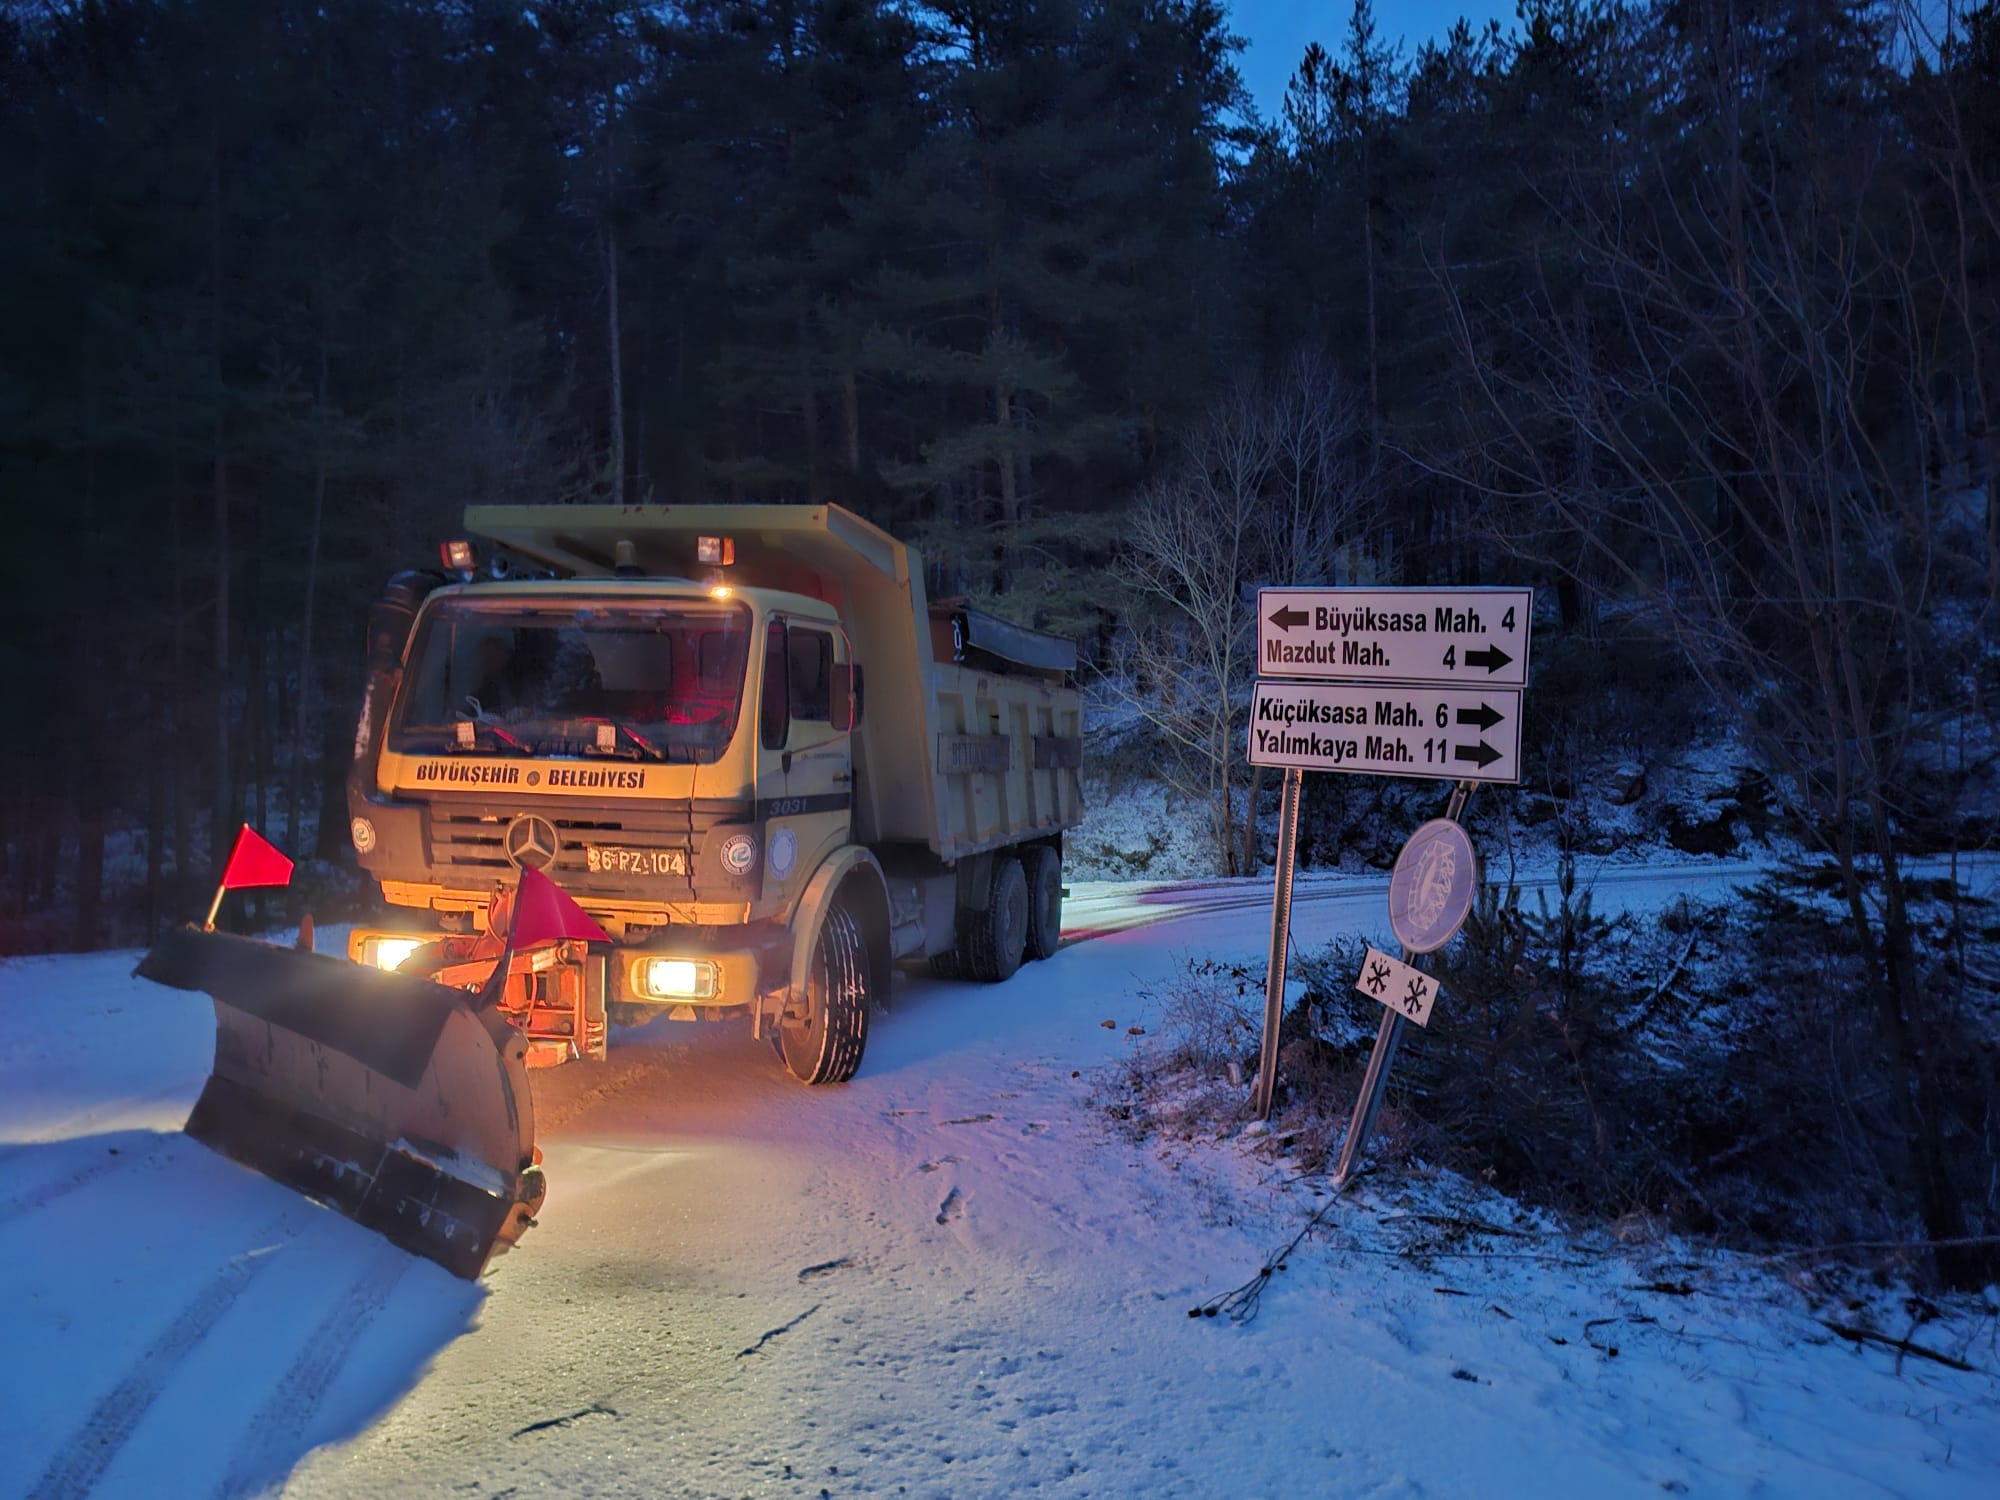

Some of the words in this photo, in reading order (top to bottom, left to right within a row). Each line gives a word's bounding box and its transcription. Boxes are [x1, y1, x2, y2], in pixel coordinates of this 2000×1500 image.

[1315, 606, 1427, 637] Büyüksasa
[1434, 607, 1487, 633] Mah.
[1501, 606, 1515, 632] 4
[1267, 639, 1336, 664] Mazdut
[1342, 641, 1390, 666] Mah.
[1442, 644, 1456, 670] 4
[1259, 698, 1367, 728] Küçüksasa
[1374, 701, 1423, 727] Mah.
[1435, 703, 1448, 728] 6
[1257, 729, 1357, 763] Yalımkaya
[1365, 736, 1413, 762] Mah.
[1424, 738, 1447, 763] 11
[416, 761, 519, 785] BÜYÜKŞEHİR
[548, 767, 646, 789] BELEDİYESİ
[651, 852, 684, 874] 104
